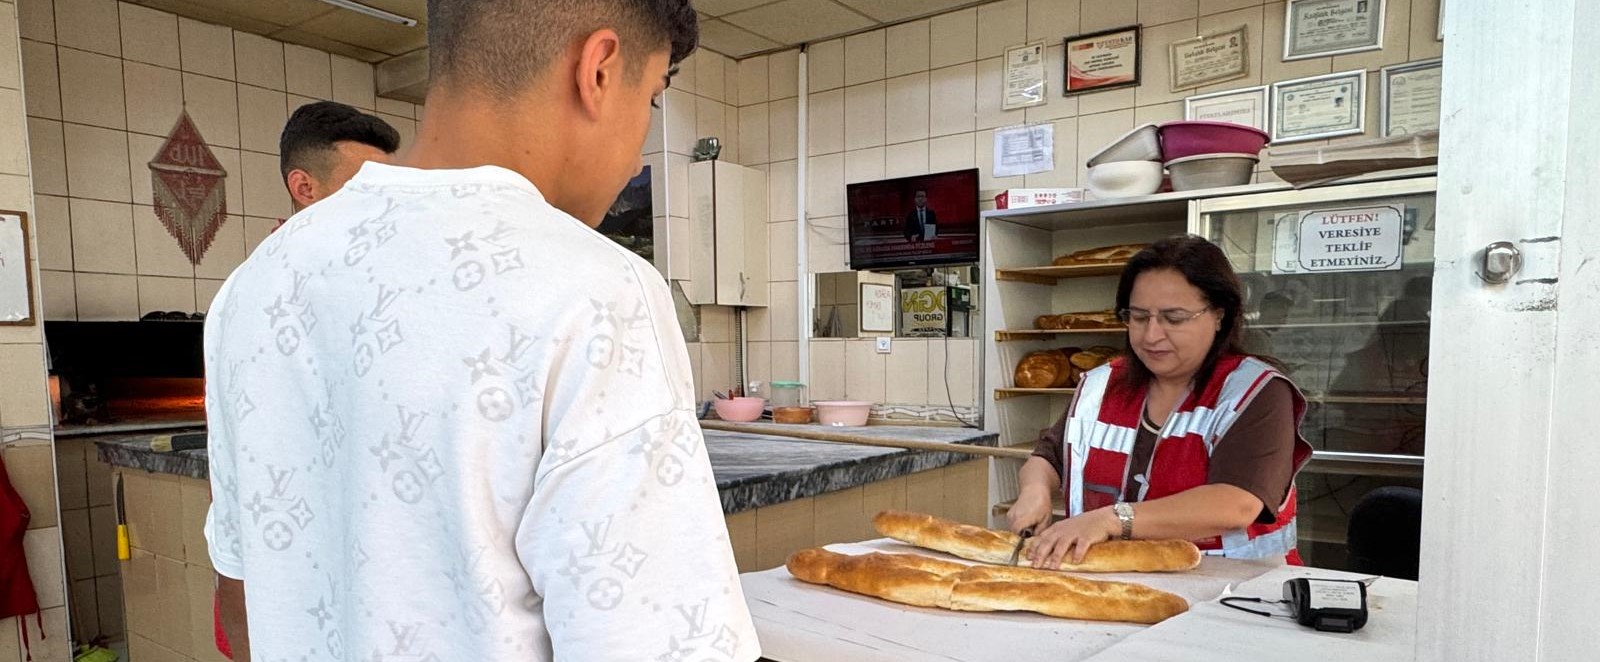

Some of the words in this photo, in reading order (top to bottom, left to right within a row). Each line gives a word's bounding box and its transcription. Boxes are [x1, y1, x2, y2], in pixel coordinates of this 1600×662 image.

[1322, 213, 1379, 225] LÜTFEN!
[1318, 227, 1381, 239] VERESİYE
[1325, 242, 1372, 253] TEKLİF
[1310, 255, 1387, 268] ETMEYİNİZ.
